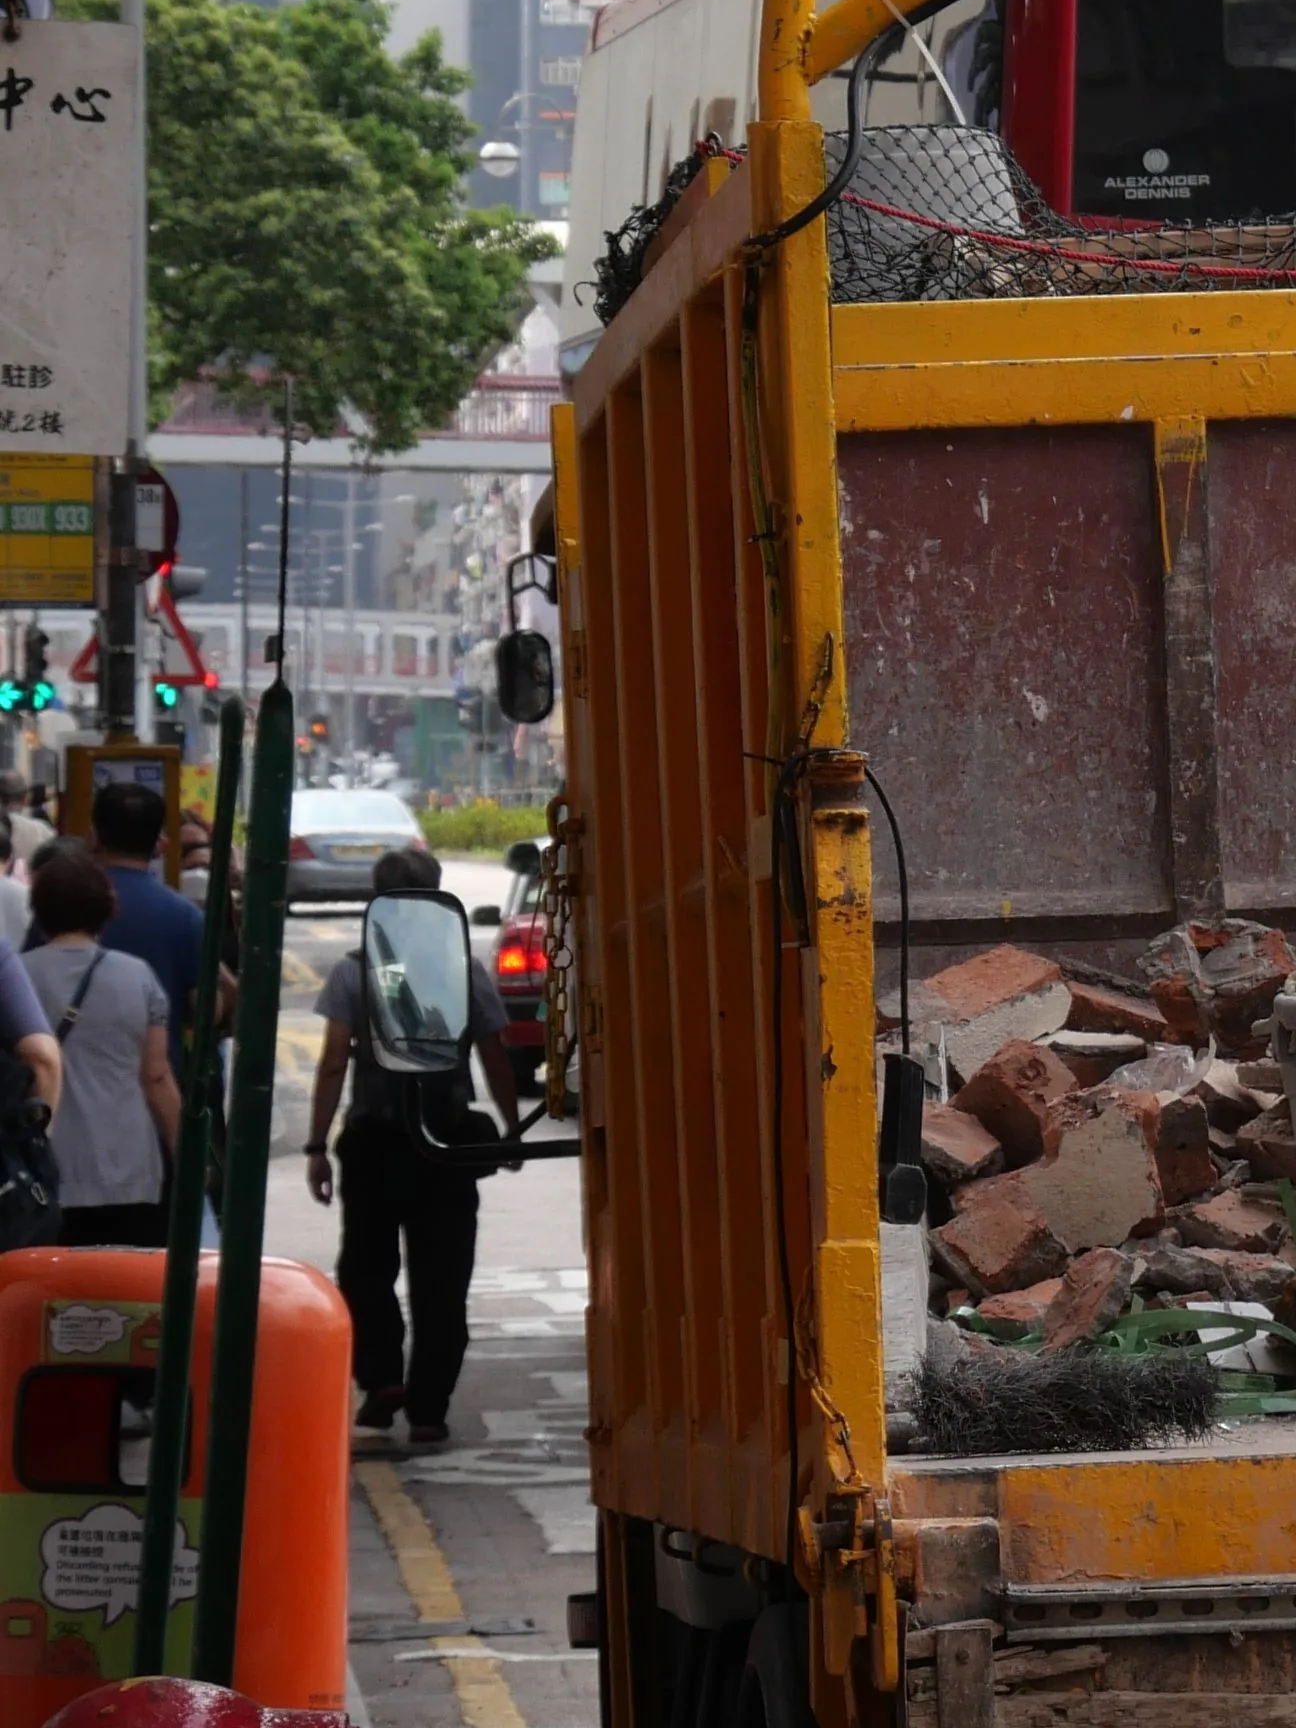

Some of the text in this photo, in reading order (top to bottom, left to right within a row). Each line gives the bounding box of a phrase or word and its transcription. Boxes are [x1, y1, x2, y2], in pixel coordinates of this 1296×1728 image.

[1104, 175, 1210, 189] ALEXANDER
[1125, 187, 1191, 200] DENNIS
[54, 505, 90, 531] 933
